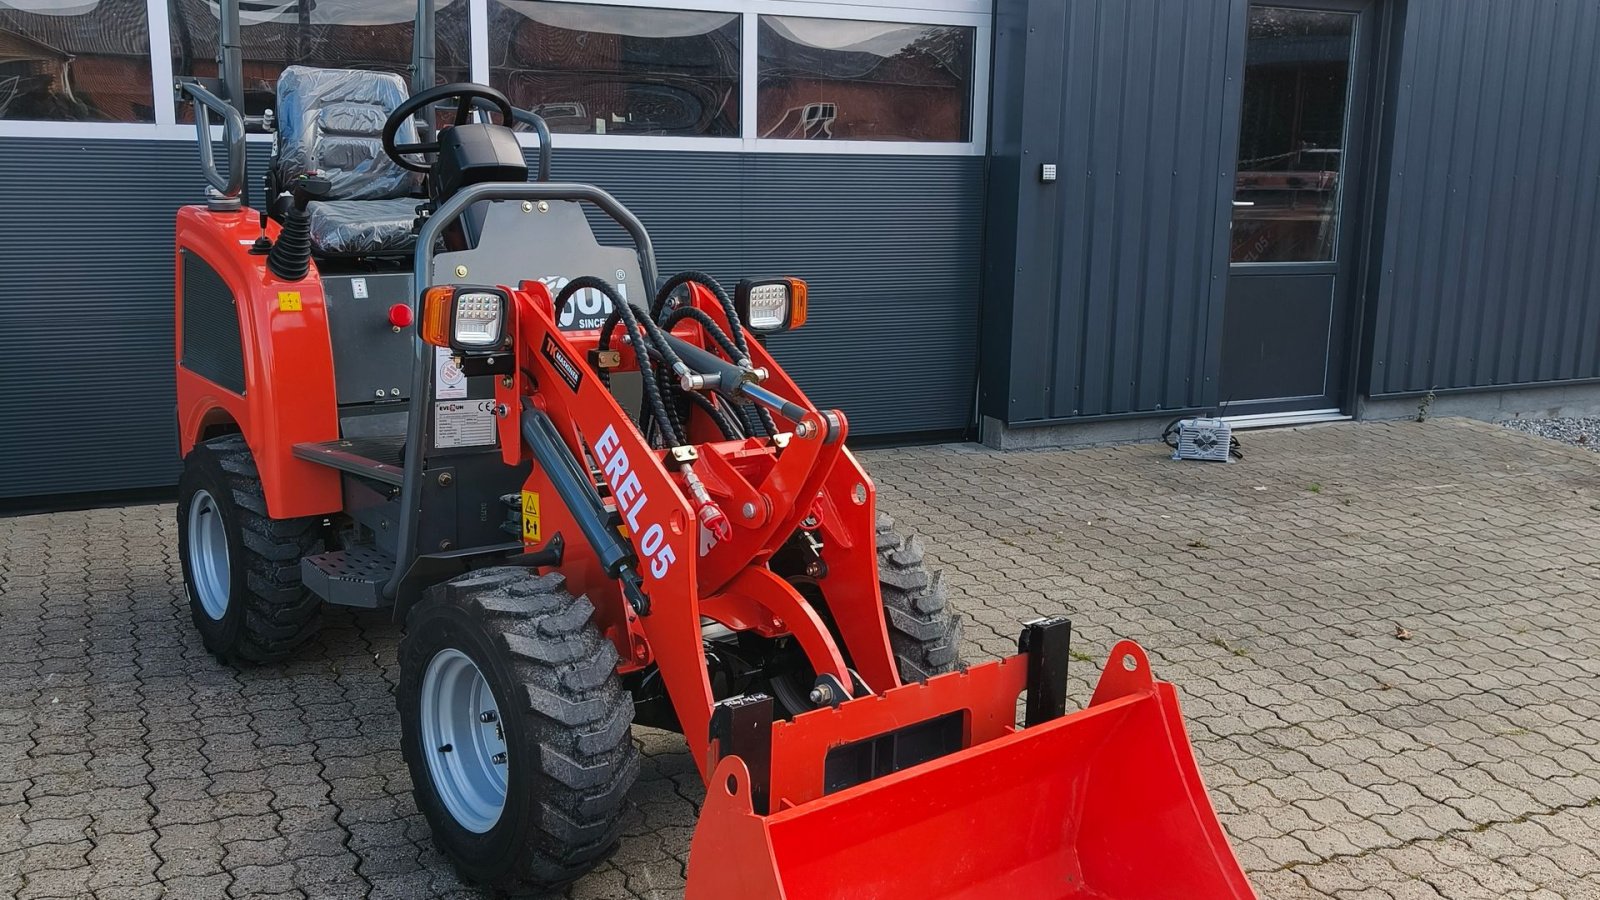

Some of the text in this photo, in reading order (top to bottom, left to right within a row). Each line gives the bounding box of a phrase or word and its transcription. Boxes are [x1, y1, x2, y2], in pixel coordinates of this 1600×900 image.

[547, 337, 558, 359] TK
[594, 424, 648, 534] EREL
[641, 523, 676, 579] 05
